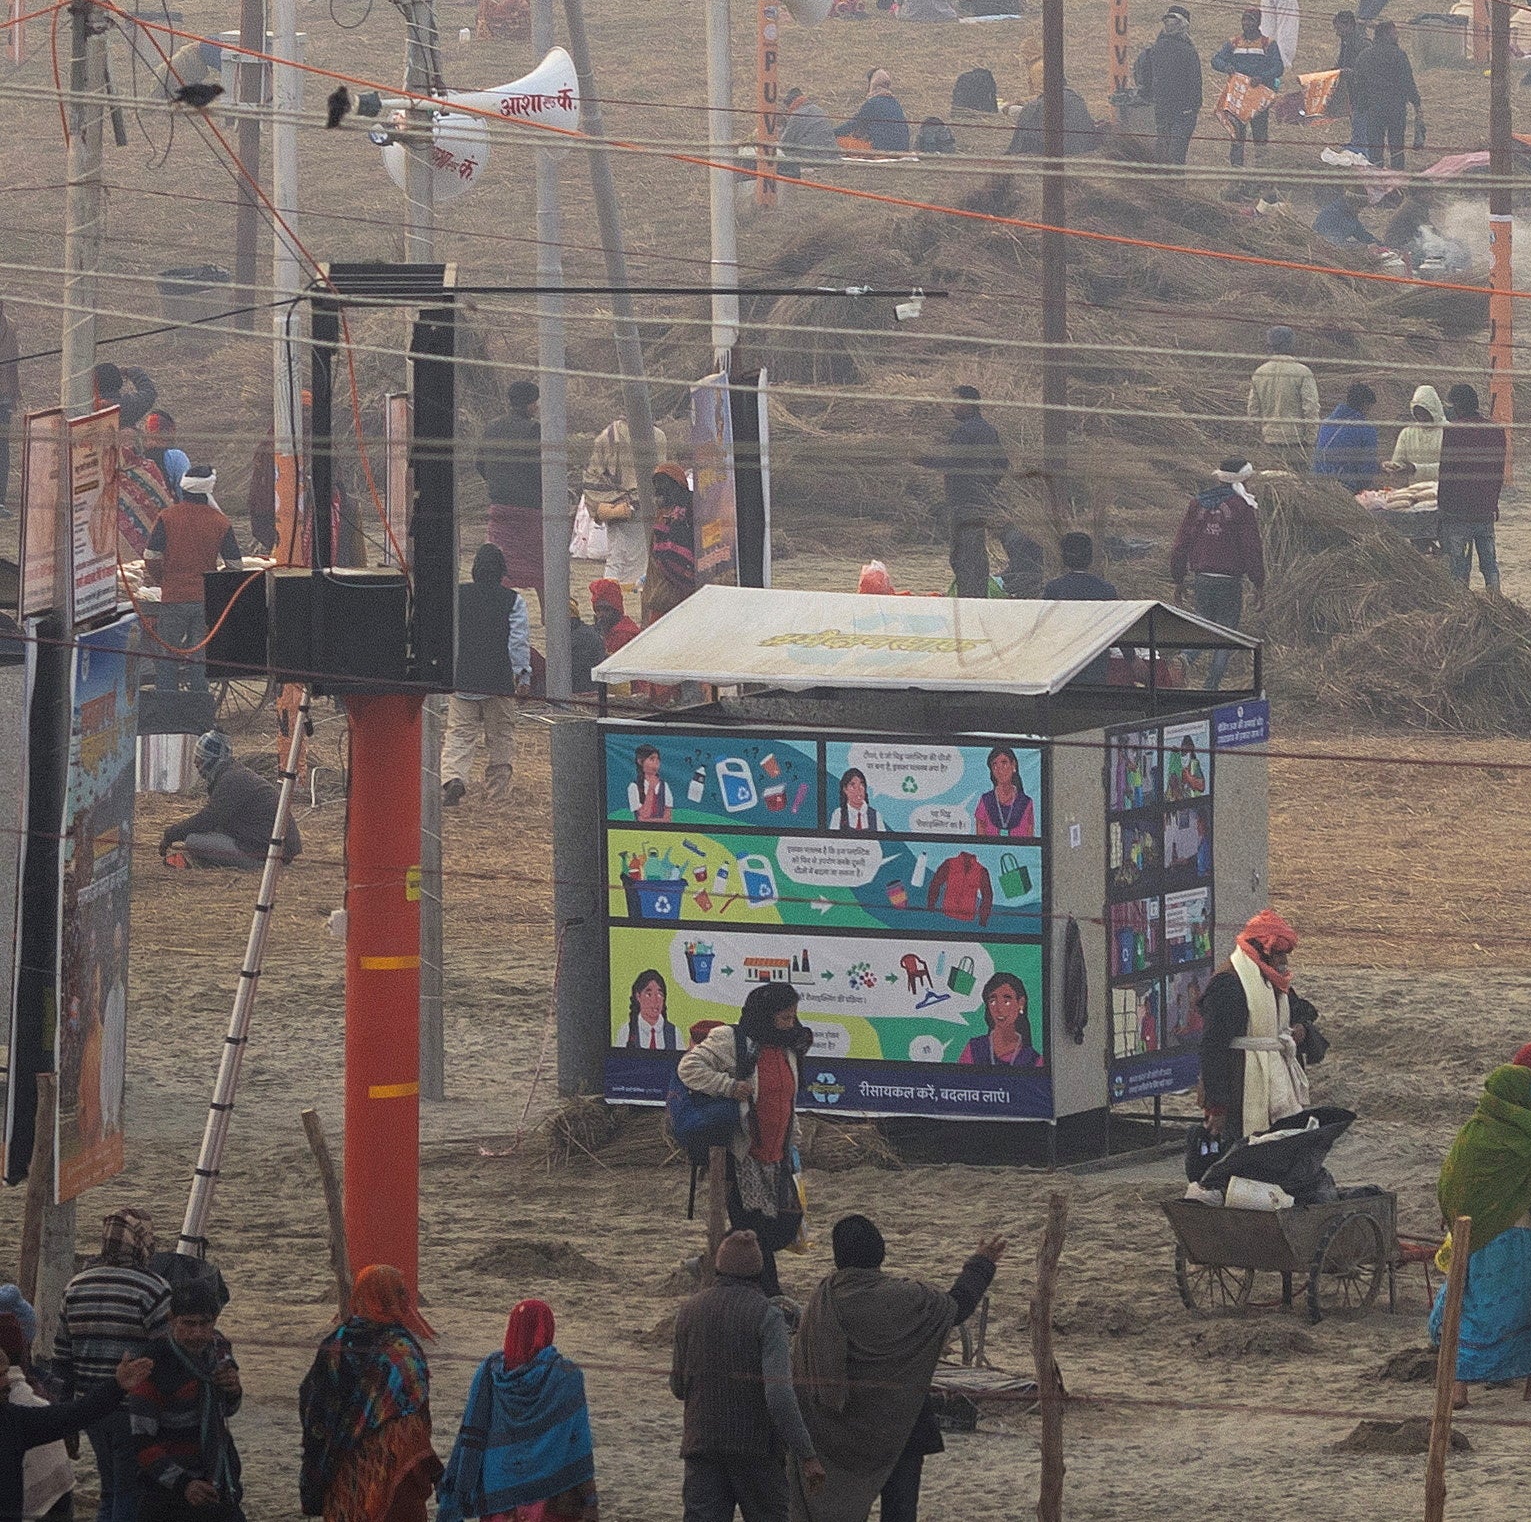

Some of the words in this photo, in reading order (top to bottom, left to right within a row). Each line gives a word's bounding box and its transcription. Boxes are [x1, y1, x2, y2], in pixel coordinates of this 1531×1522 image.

[500, 94, 543, 117] आशा
[859, 1081, 915, 1099] रीसायकल
[916, 1083, 938, 1101] करें,
[940, 1088, 979, 1102] बदलाव
[982, 1088, 1010, 1103] लाएं।
